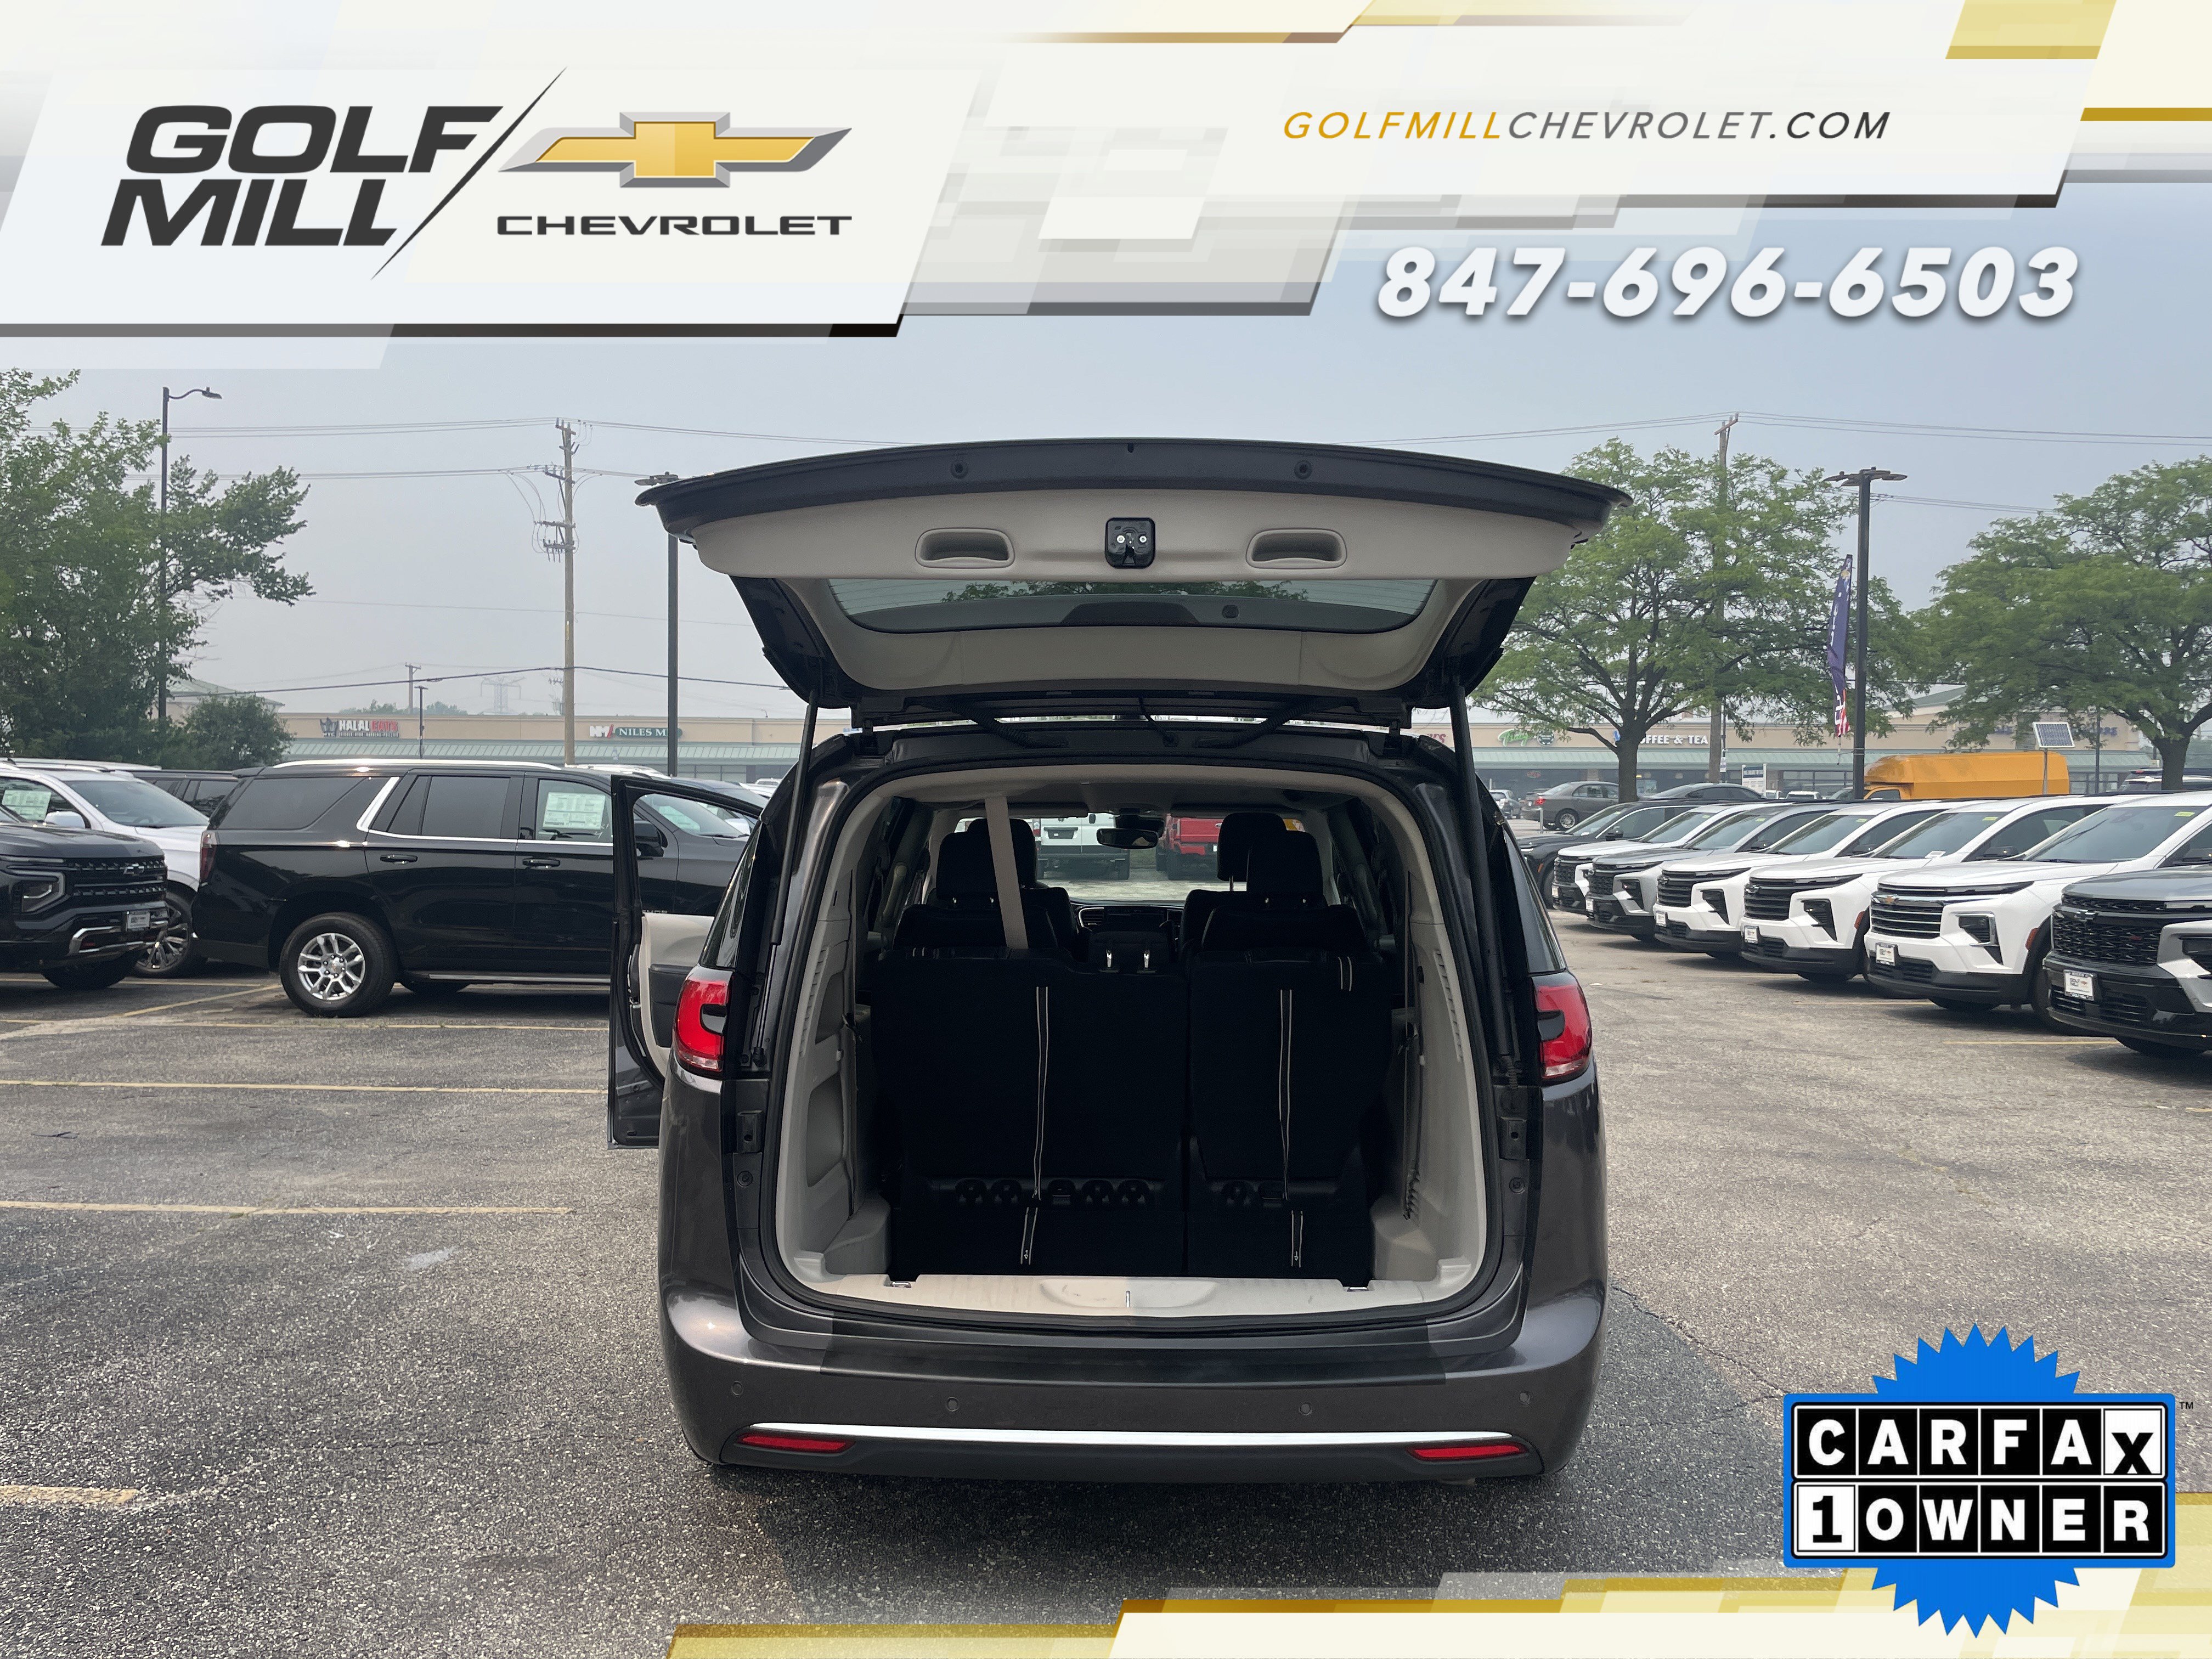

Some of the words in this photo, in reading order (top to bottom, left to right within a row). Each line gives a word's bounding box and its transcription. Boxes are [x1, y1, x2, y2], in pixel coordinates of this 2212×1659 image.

[338, 720, 370, 731] HALAL
[371, 720, 398, 732] EATS
[619, 728, 652, 736] NILES
[1673, 735, 1683, 744] &
[1688, 735, 1708, 744] TEA
